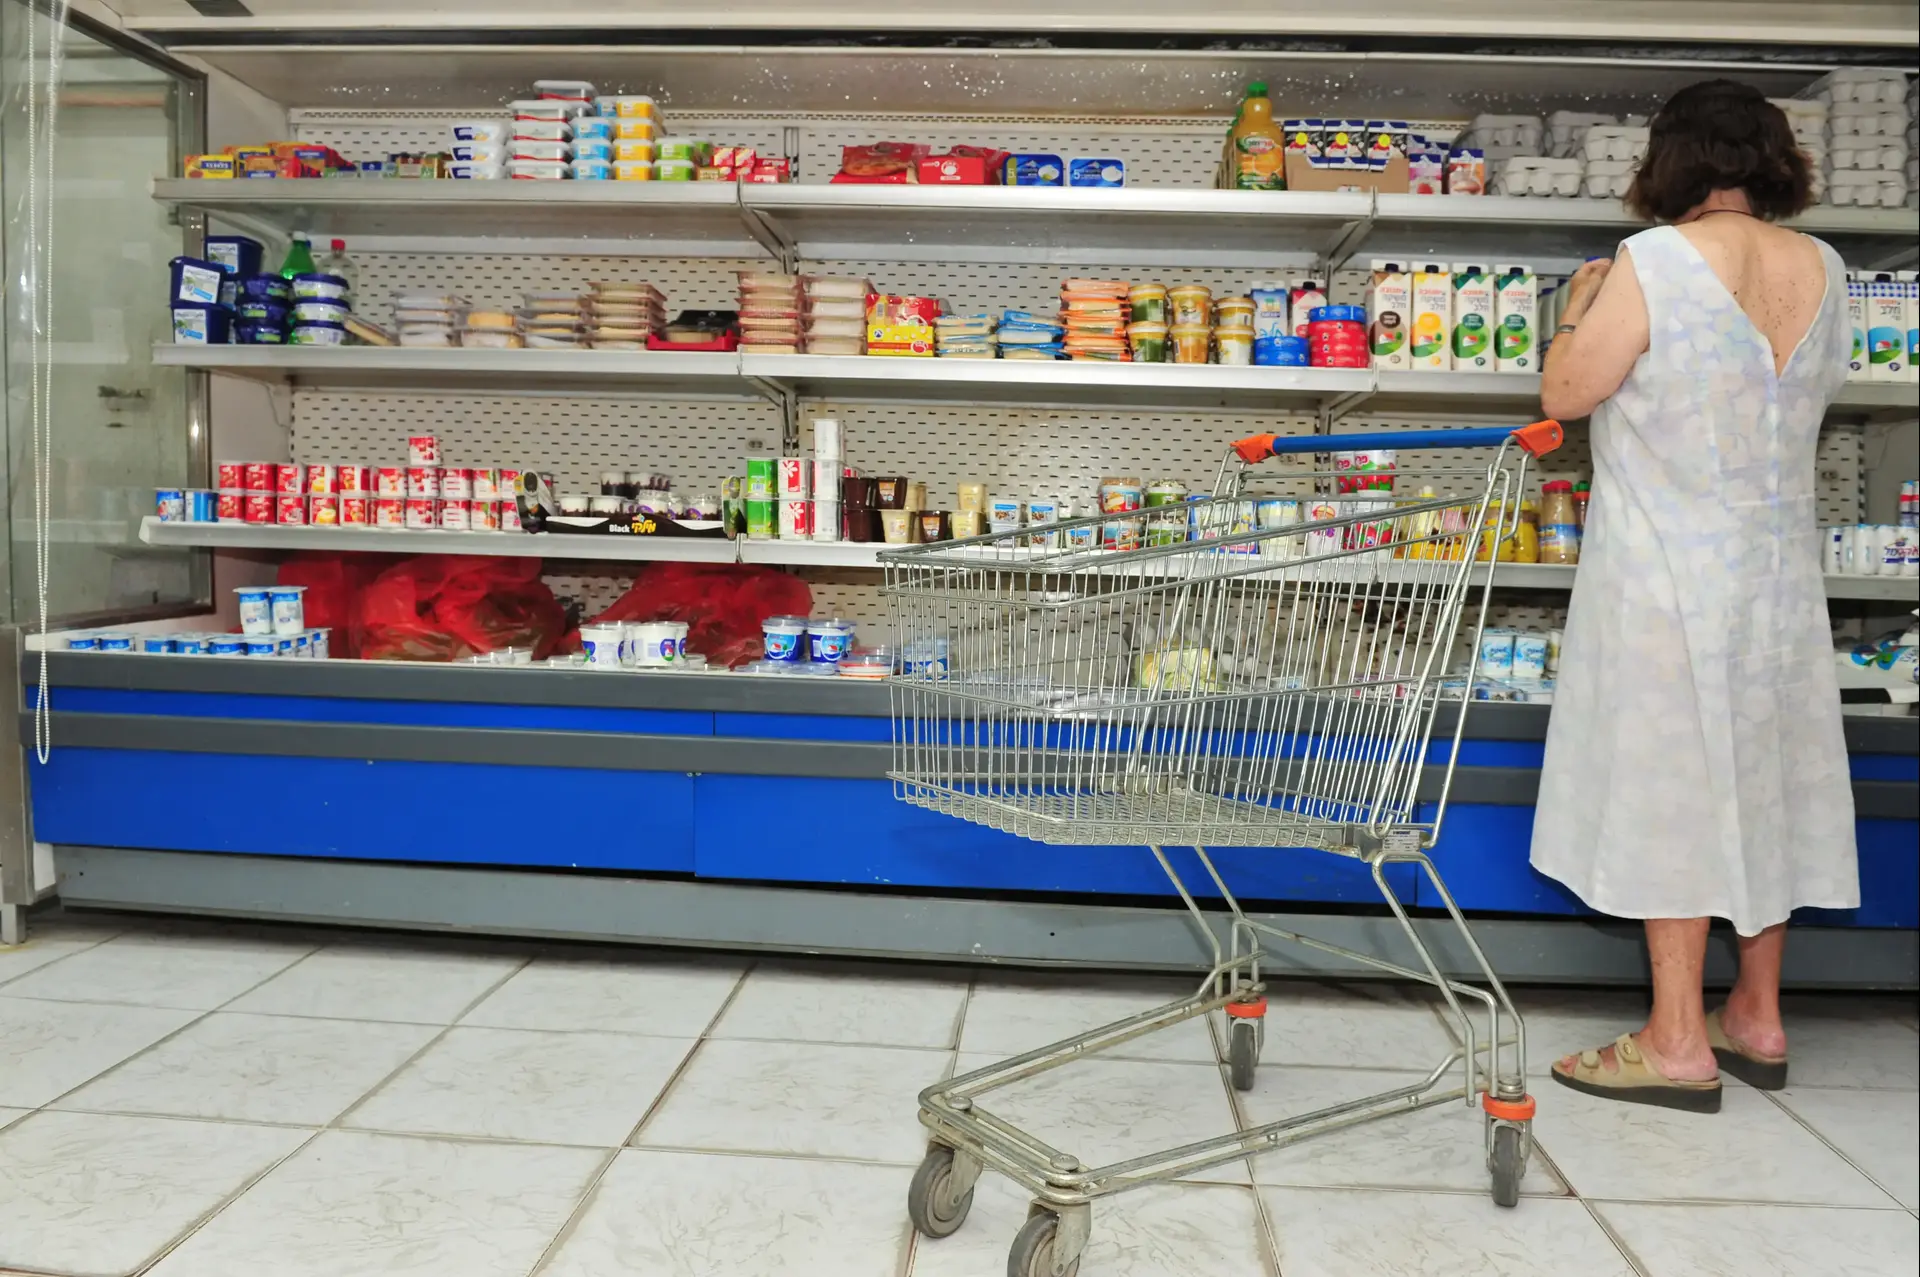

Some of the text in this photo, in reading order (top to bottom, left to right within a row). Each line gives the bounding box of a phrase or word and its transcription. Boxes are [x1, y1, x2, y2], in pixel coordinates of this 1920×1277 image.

[1073, 169, 1080, 179] 5
[609, 520, 656, 533] מילקי Black
